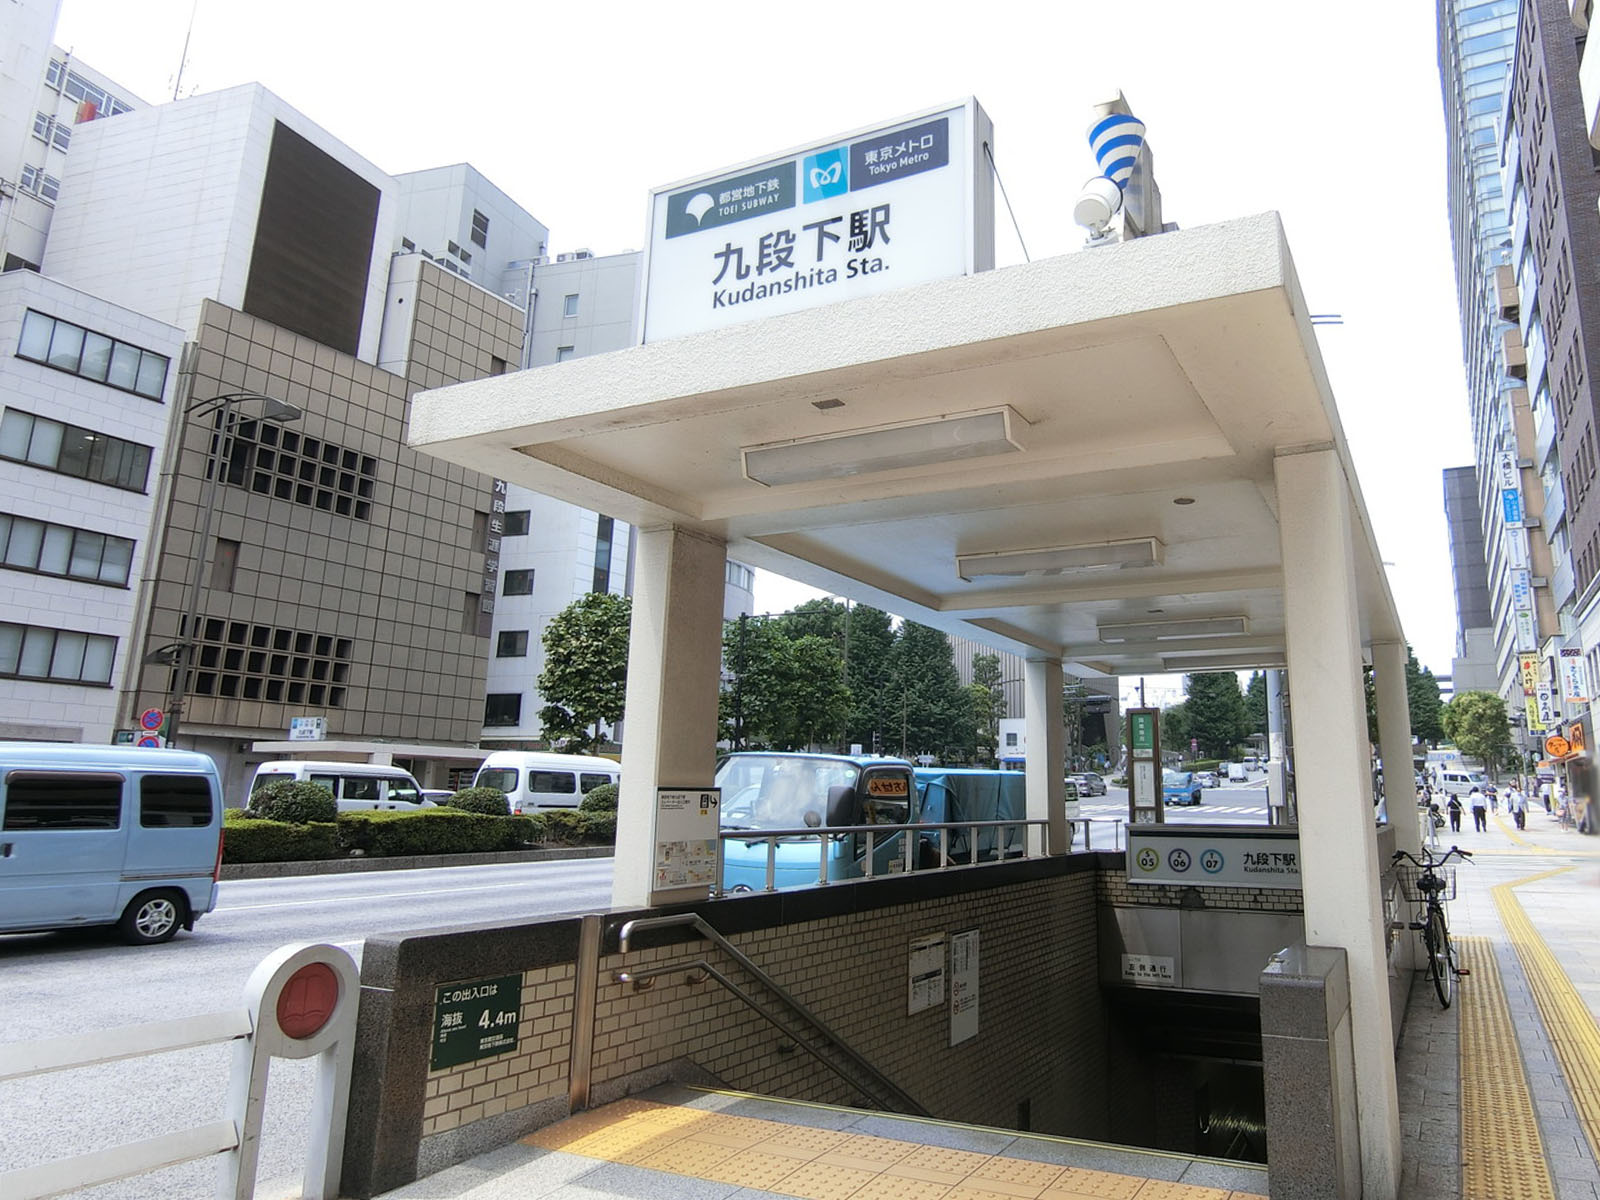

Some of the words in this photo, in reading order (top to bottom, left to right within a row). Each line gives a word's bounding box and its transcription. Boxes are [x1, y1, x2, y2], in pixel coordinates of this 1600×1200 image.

[864, 134, 933, 166] 東京メトロ
[869, 161, 897, 175] Tokyo
[899, 152, 929, 168] Metro
[719, 177, 780, 205] 都営地下鉄
[719, 204, 738, 217] TOEI
[741, 193, 780, 211] SUBWAY
[712, 203, 891, 286] 九段下駅
[713, 267, 838, 309] Kudanshita
[846, 256, 890, 279] Sta.
[1141, 858, 1154, 867] 05
[1173, 859, 1186, 867] 06
[1206, 860, 1218, 868] 07
[1243, 852, 1297, 866] 九段下駅
[442, 984, 498, 1004] この出入口は
[478, 1009, 517, 1029] 4.4m
